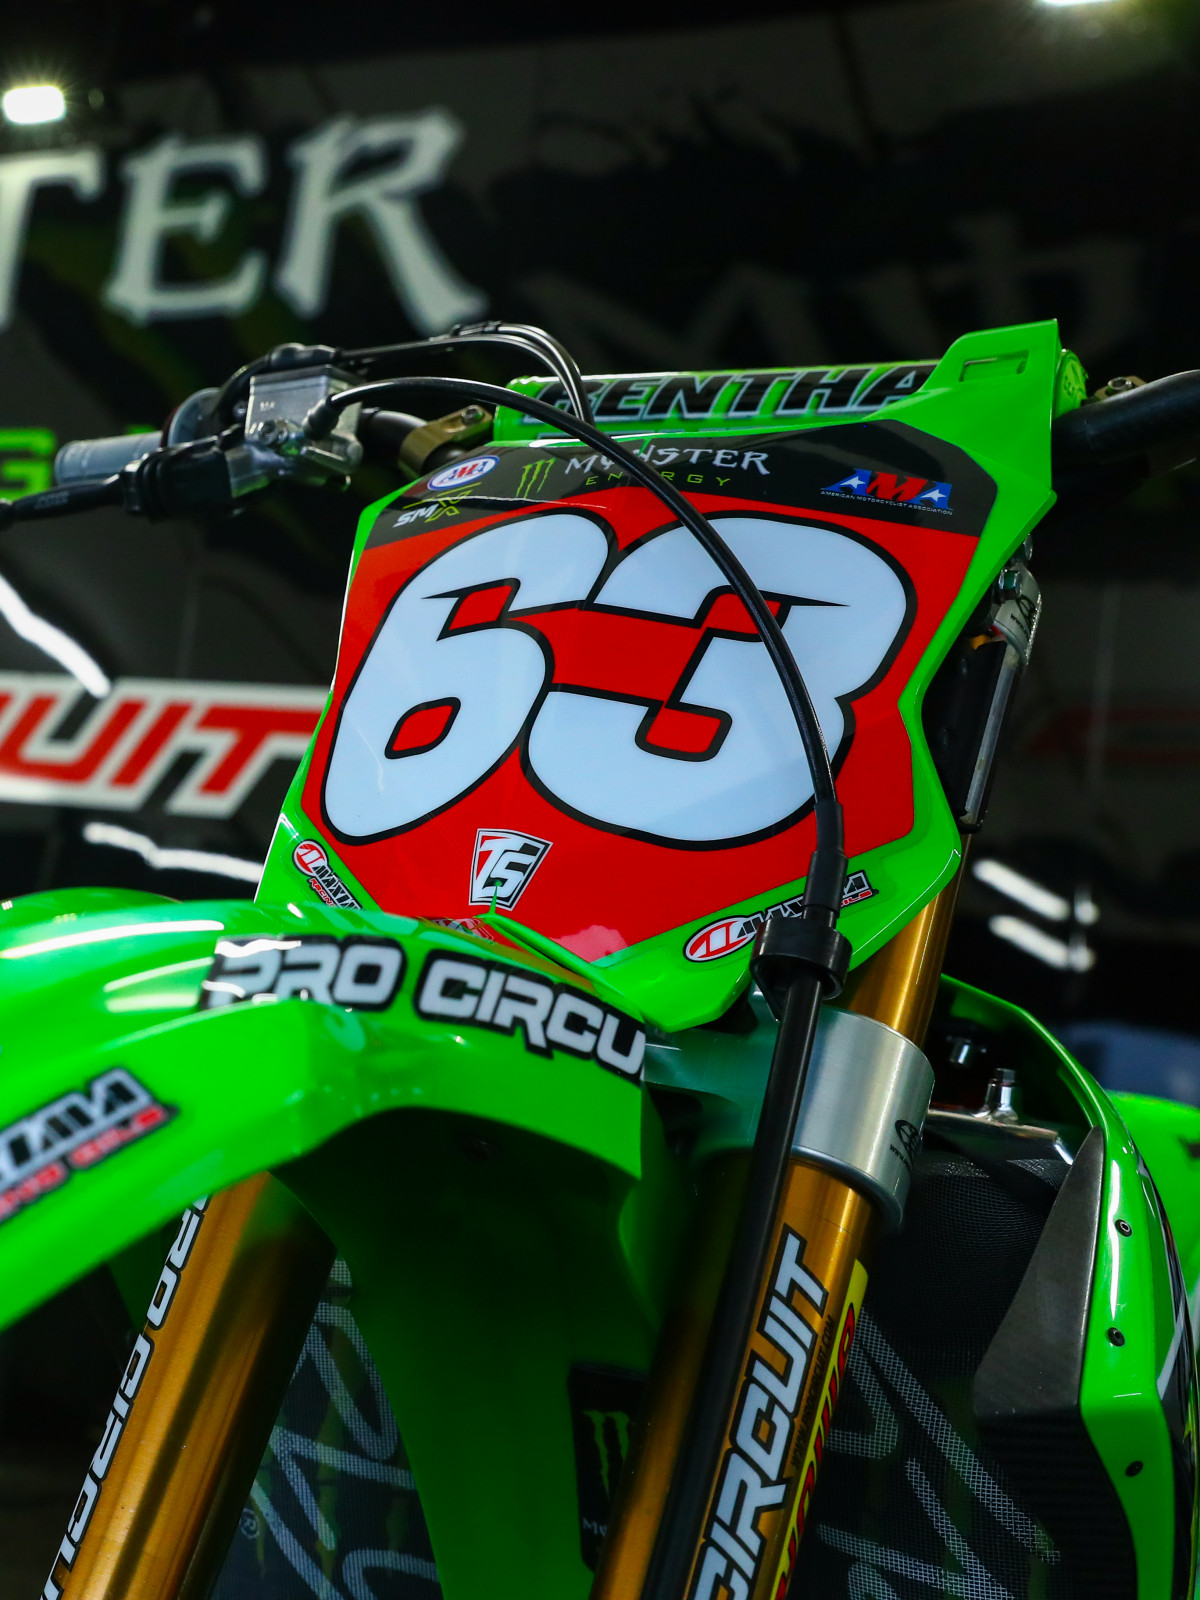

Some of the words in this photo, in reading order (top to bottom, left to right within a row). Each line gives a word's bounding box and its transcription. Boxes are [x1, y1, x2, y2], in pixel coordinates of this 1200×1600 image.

[585, 471, 732, 487] ENRGY
[820, 489, 855, 500] AMERICAN
[856, 496, 907, 508] MOTORCYCLIST
[908, 503, 953, 516] ASSOCIATION
[822, 468, 953, 510] AMA
[323, 512, 912, 847] 63
[206, 937, 404, 1008] PRO
[416, 955, 646, 1078] CIRCU
[692, 1230, 824, 1600] CIRCUIT
